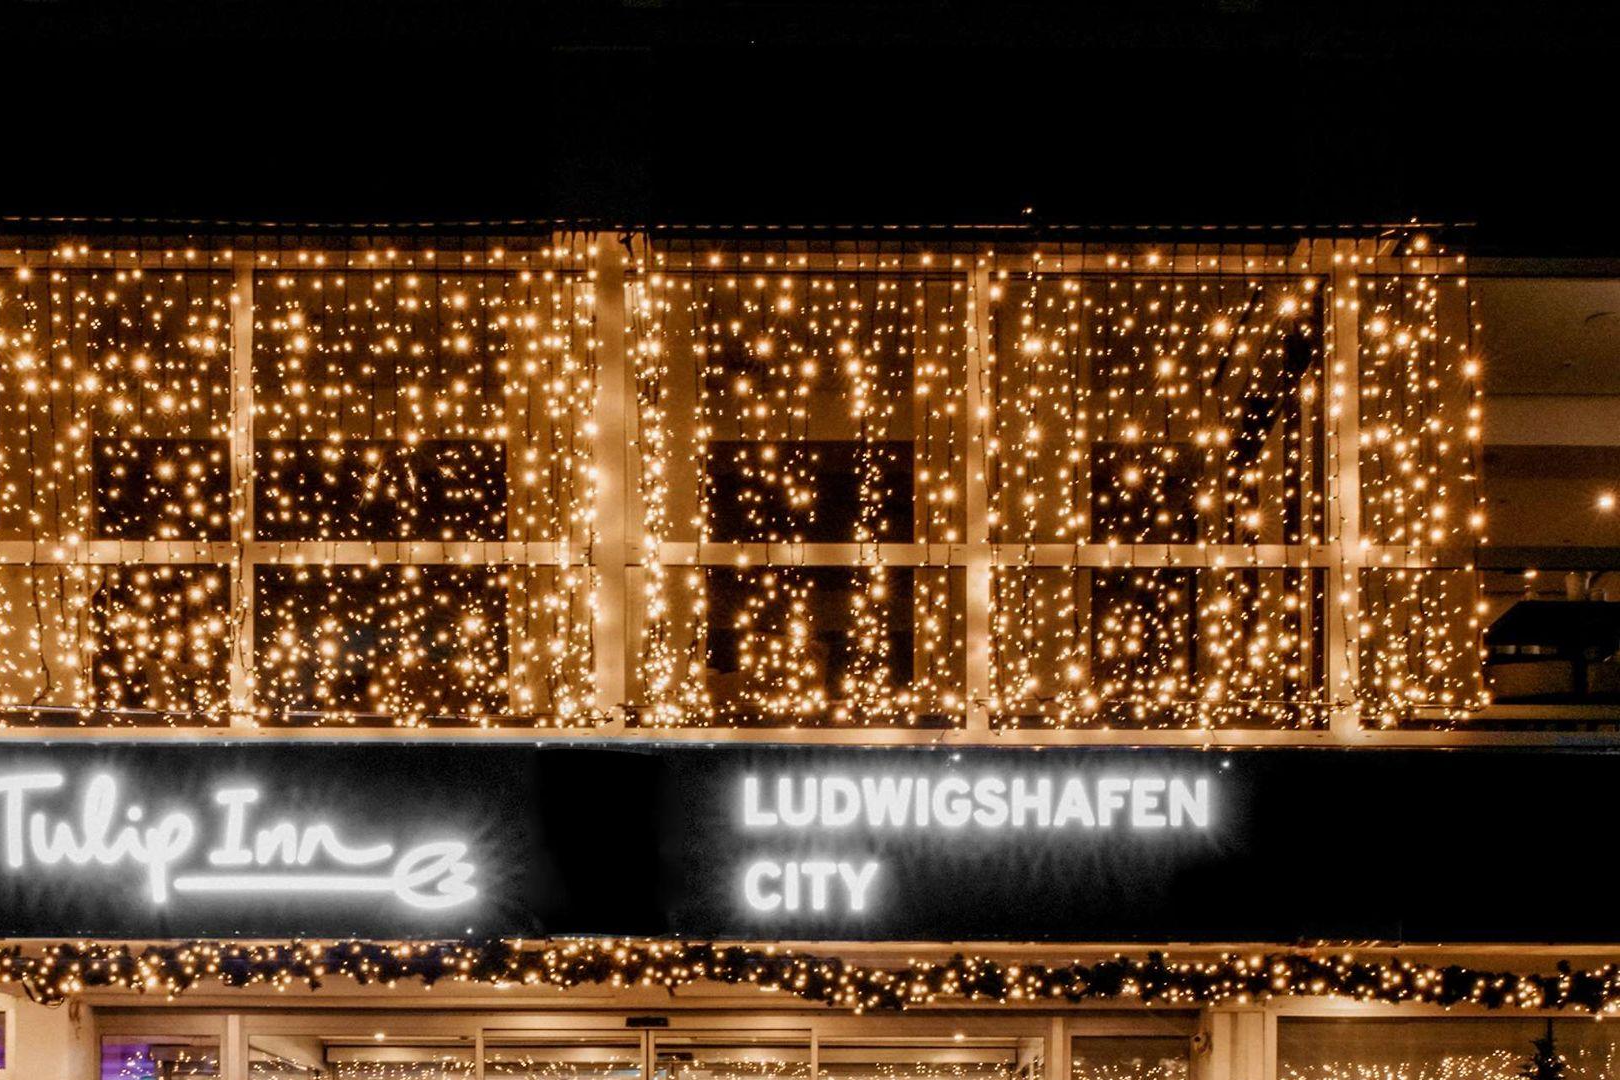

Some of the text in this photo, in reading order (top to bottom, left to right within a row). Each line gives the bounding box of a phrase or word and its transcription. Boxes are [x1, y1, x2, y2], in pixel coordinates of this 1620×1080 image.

[209, 787, 394, 866] Inn
[743, 777, 1209, 827] LUDWIGSHAFEN
[743, 861, 879, 912] CITY
